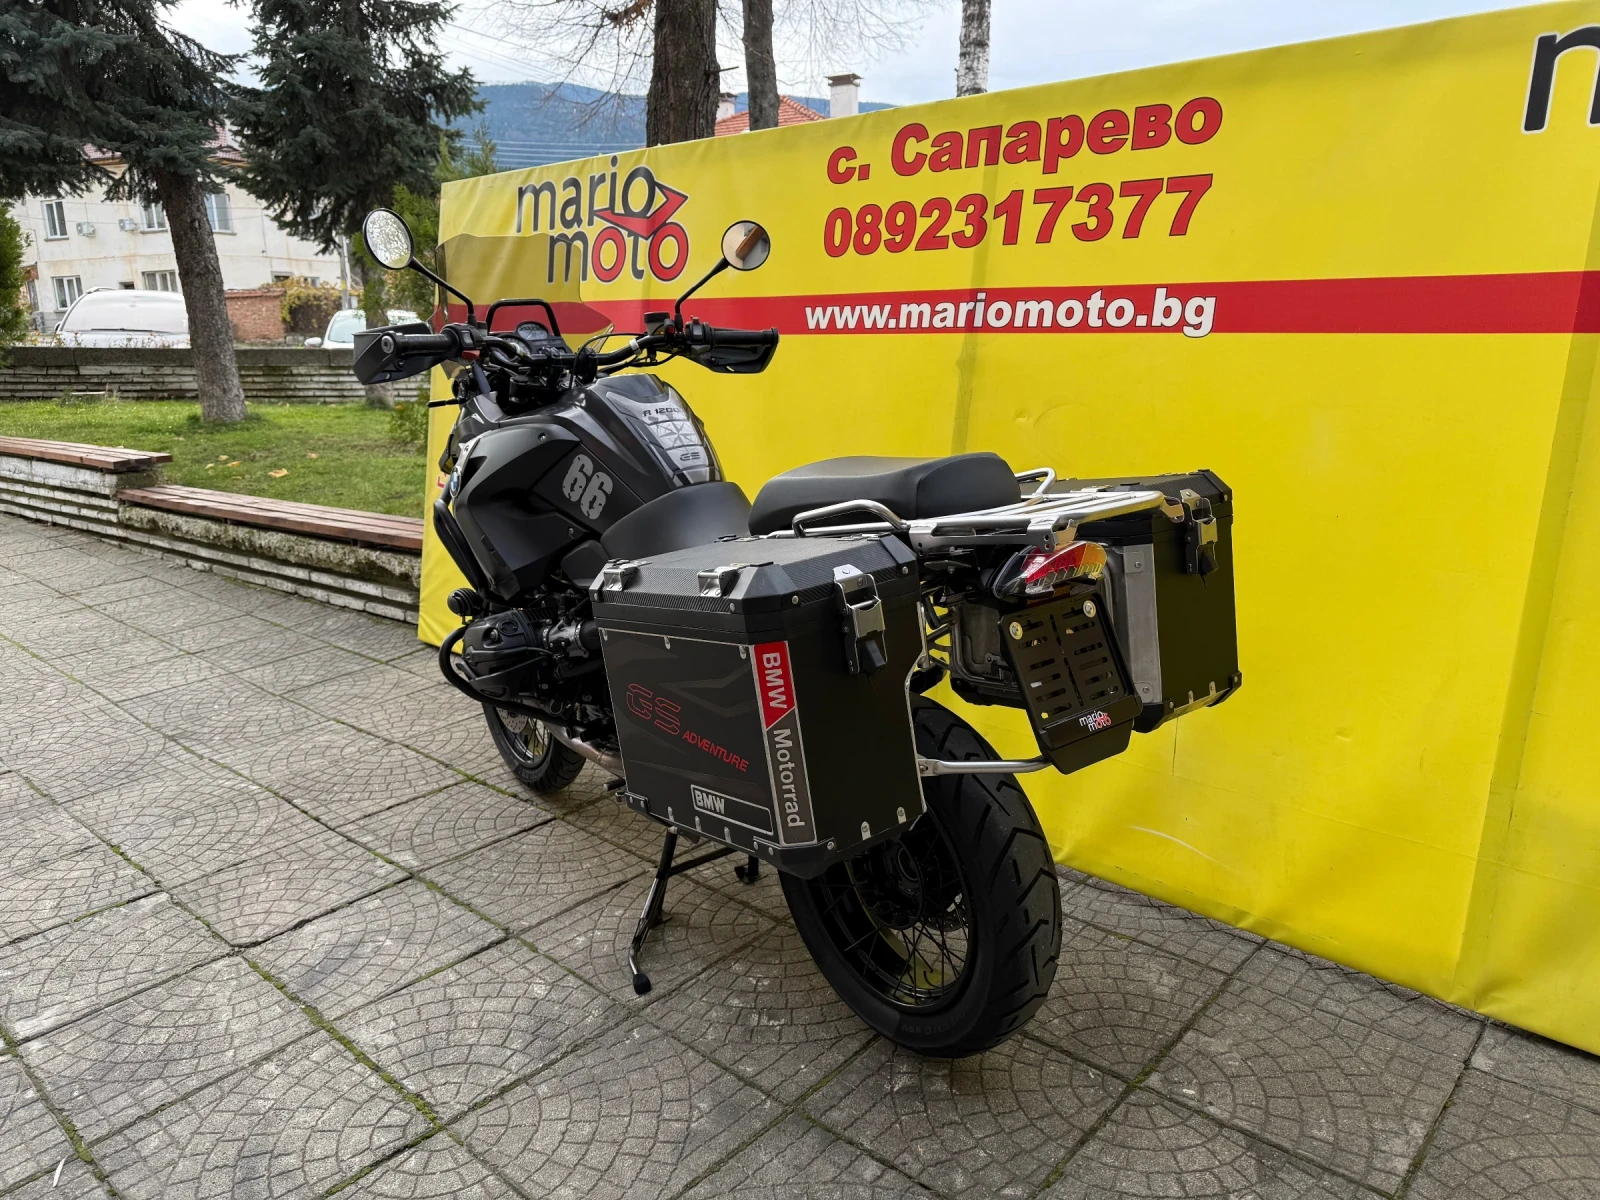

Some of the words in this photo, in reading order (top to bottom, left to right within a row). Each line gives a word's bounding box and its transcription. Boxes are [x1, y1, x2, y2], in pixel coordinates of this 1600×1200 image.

[827, 146, 870, 184] с.
[891, 96, 1223, 177] Сапарево
[516, 155, 656, 233] mario
[824, 173, 1213, 257] 0892317377
[547, 221, 689, 283] moto
[804, 288, 1217, 338] www.mariomoto.bg
[562, 453, 614, 520] 66
[763, 652, 788, 709] BMW
[626, 683, 681, 735] GS
[682, 730, 749, 773] ADVENTURE
[1079, 710, 1104, 727] mario
[1087, 716, 1111, 732] moto
[694, 789, 725, 815] BMW
[773, 728, 805, 828] Motorrad
